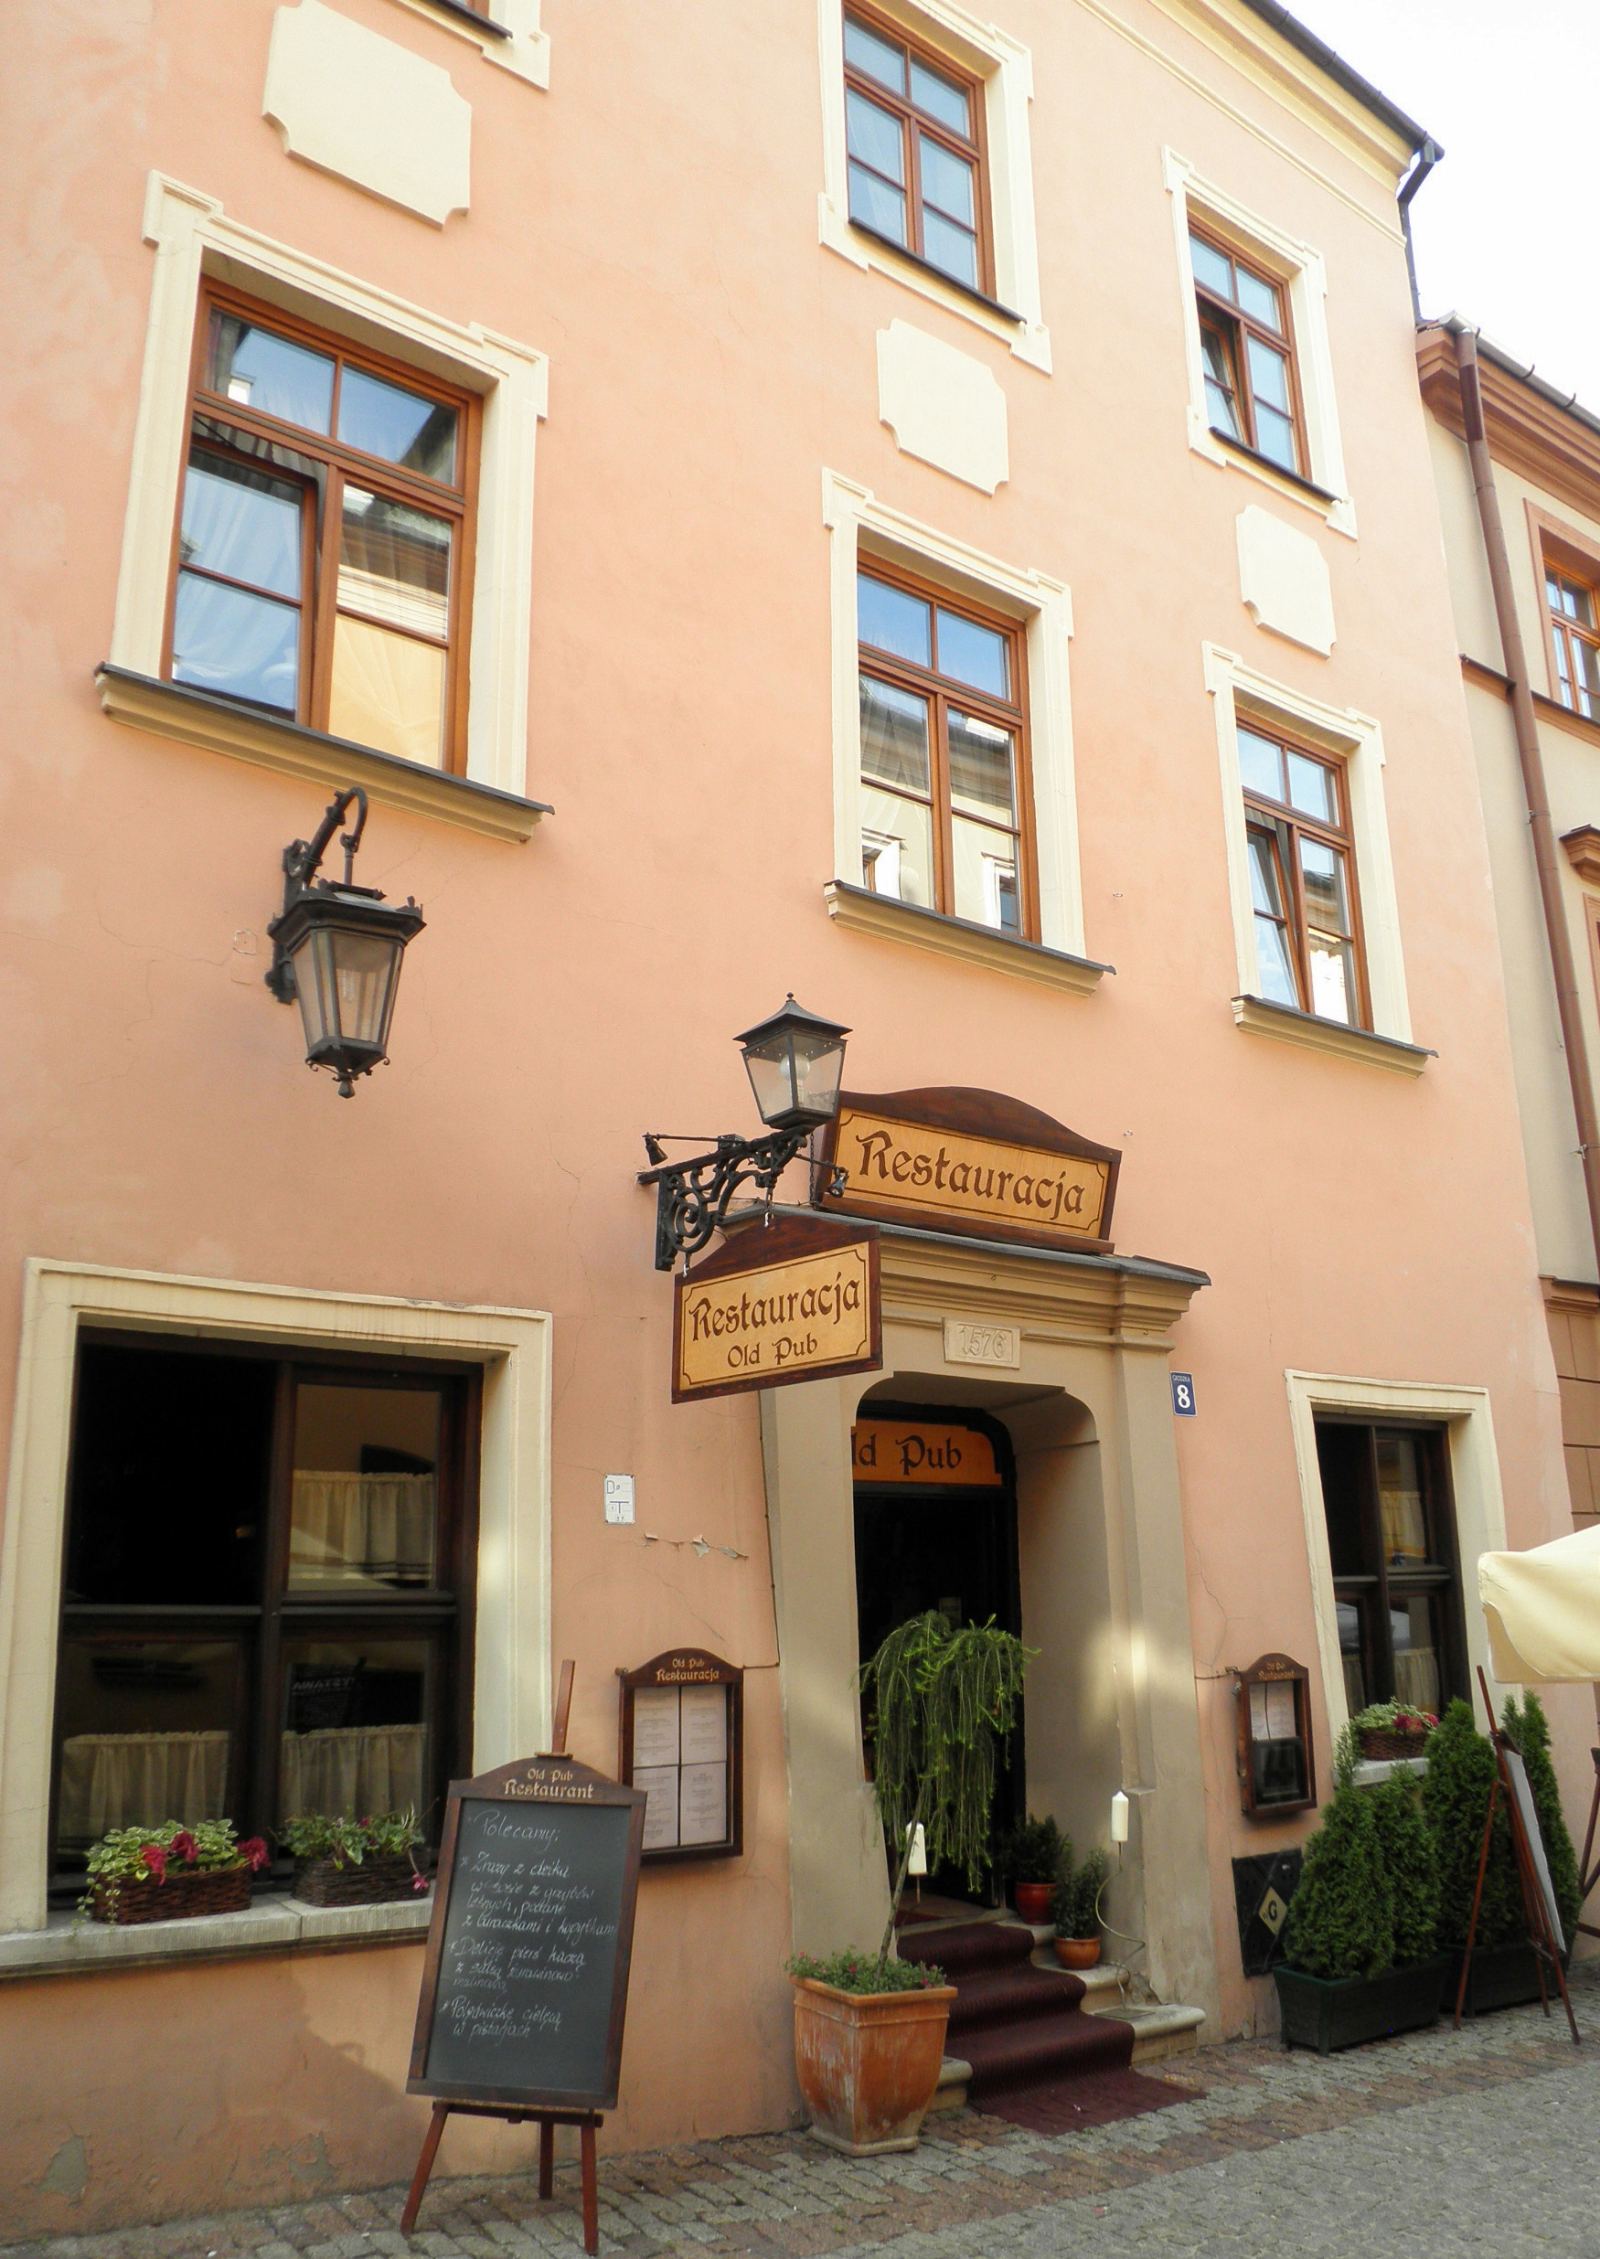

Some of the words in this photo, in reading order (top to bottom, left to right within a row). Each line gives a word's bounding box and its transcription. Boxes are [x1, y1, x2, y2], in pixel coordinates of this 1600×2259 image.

[856, 1130, 1086, 1220] Restauracja
[689, 1271, 860, 1341] Restauracja
[727, 1343, 760, 1368] Old
[772, 1332, 818, 1366] Pub
[960, 1326, 1007, 1359] 1576
[1177, 1384, 1191, 1409] 8
[850, 1432, 877, 1467] ld
[895, 1434, 962, 1476] Pub
[656, 1668, 720, 1682] Restauracja
[672, 1658, 685, 1668] Old
[688, 1657, 705, 1669] Pub
[503, 1778, 594, 1799] Restaurant
[527, 1768, 546, 1781] Old
[551, 1769, 574, 1784] Pub
